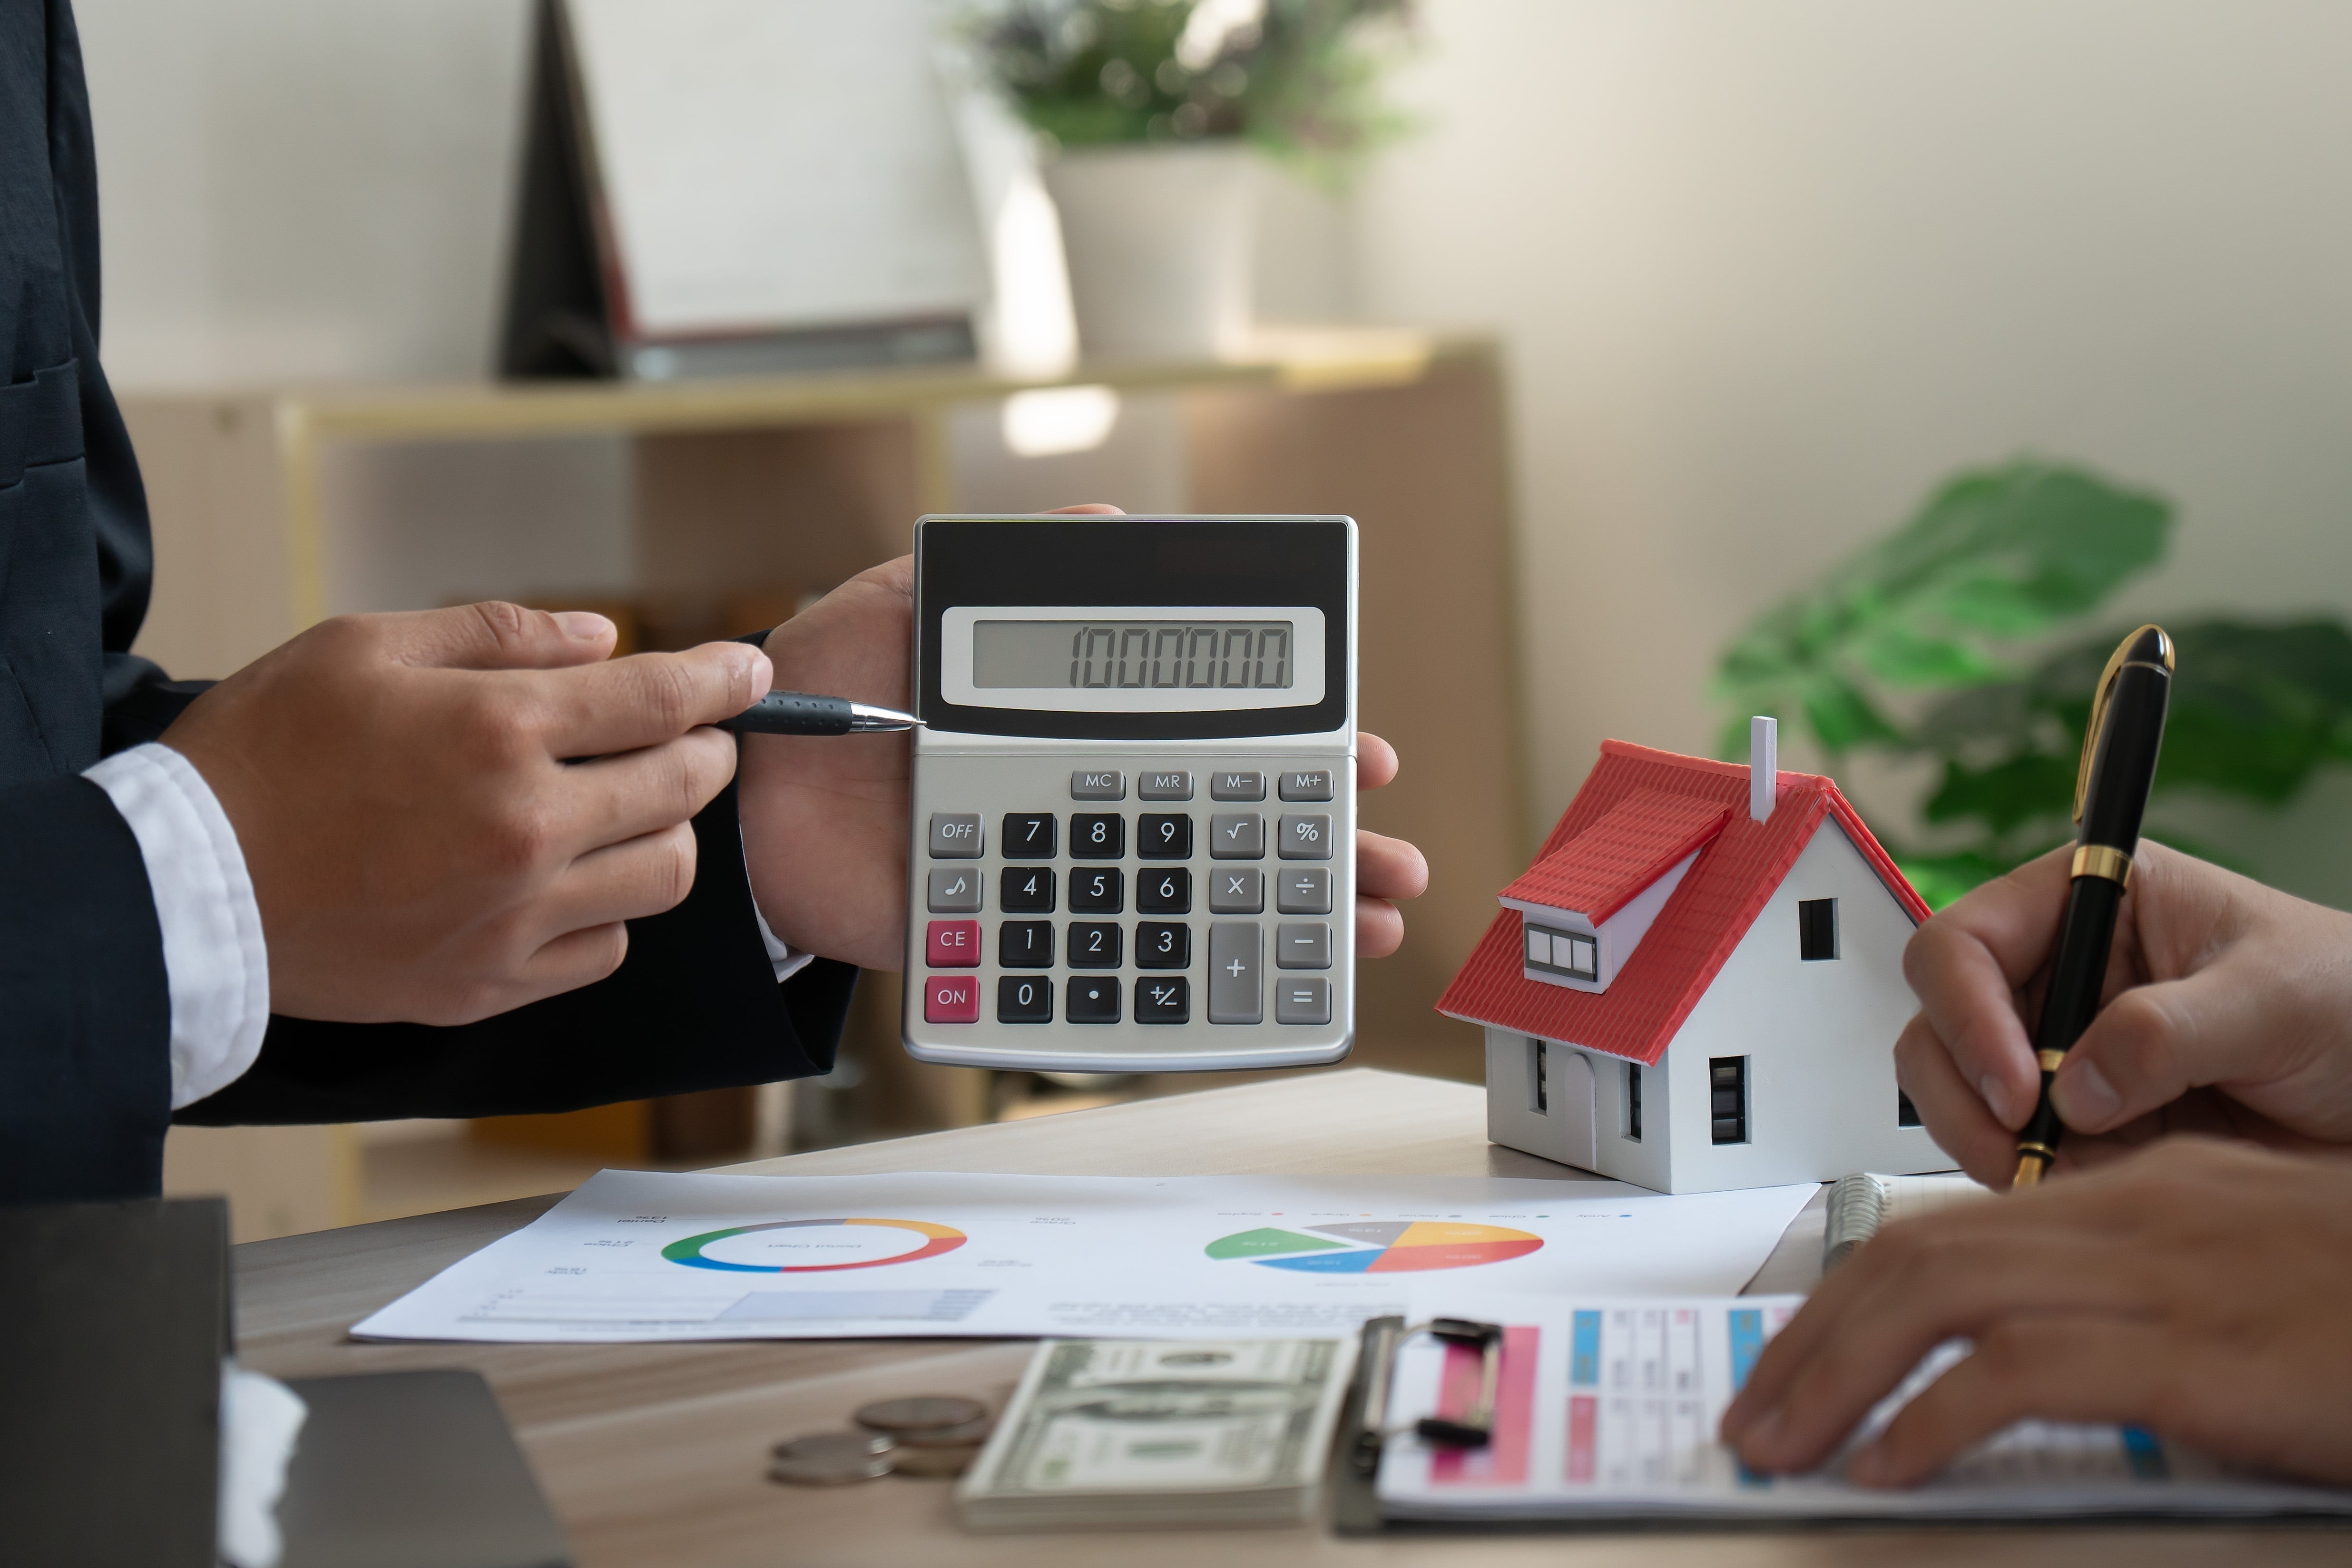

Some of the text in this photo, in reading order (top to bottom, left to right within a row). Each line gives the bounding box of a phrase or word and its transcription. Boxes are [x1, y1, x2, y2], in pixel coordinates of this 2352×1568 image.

[1086, 774, 1111, 787] MC
[1155, 775, 1180, 787] MR
[1296, 774, 1321, 787] M+
[942, 823, 973, 838] OFF
[1026, 821, 1040, 842] 7
[1091, 822, 1106, 843] 8
[1161, 822, 1175, 843] 9
[1296, 823, 1318, 841] %
[1023, 875, 1037, 895] 4
[1090, 876, 1105, 897] 5
[1160, 877, 1174, 898] 6
[941, 931, 965, 946] CE
[1027, 929, 1032, 949] 1
[1088, 931, 1102, 951] 2
[1158, 931, 1172, 952] 3
[938, 990, 965, 1004] ON
[1019, 984, 1032, 1005] 0
